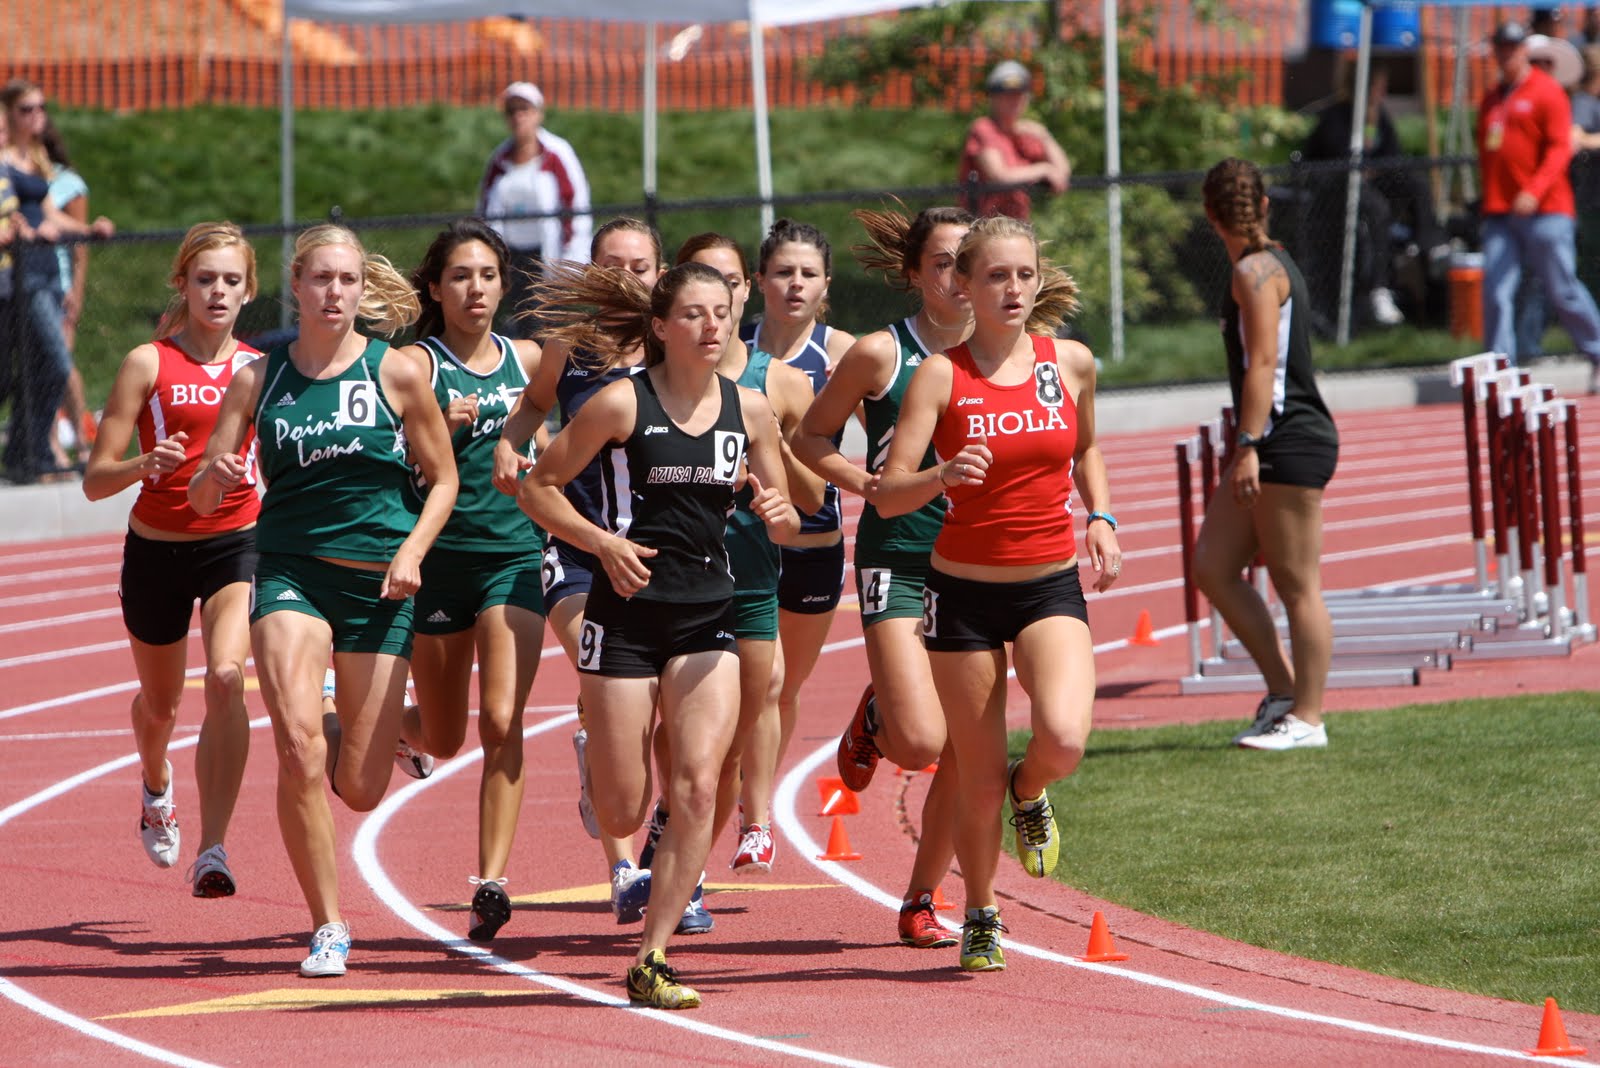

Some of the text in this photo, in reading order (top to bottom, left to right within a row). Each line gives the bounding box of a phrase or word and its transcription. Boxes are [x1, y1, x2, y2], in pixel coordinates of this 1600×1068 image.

[171, 384, 227, 405] BIO
[1037, 364, 1062, 403] 8
[348, 384, 368, 423] 6
[967, 407, 1068, 438] BIOLA
[297, 437, 364, 467] Loma
[722, 435, 738, 479] 9
[647, 466, 692, 484] AZUSA
[866, 571, 883, 610] 4
[581, 623, 596, 667] 9
